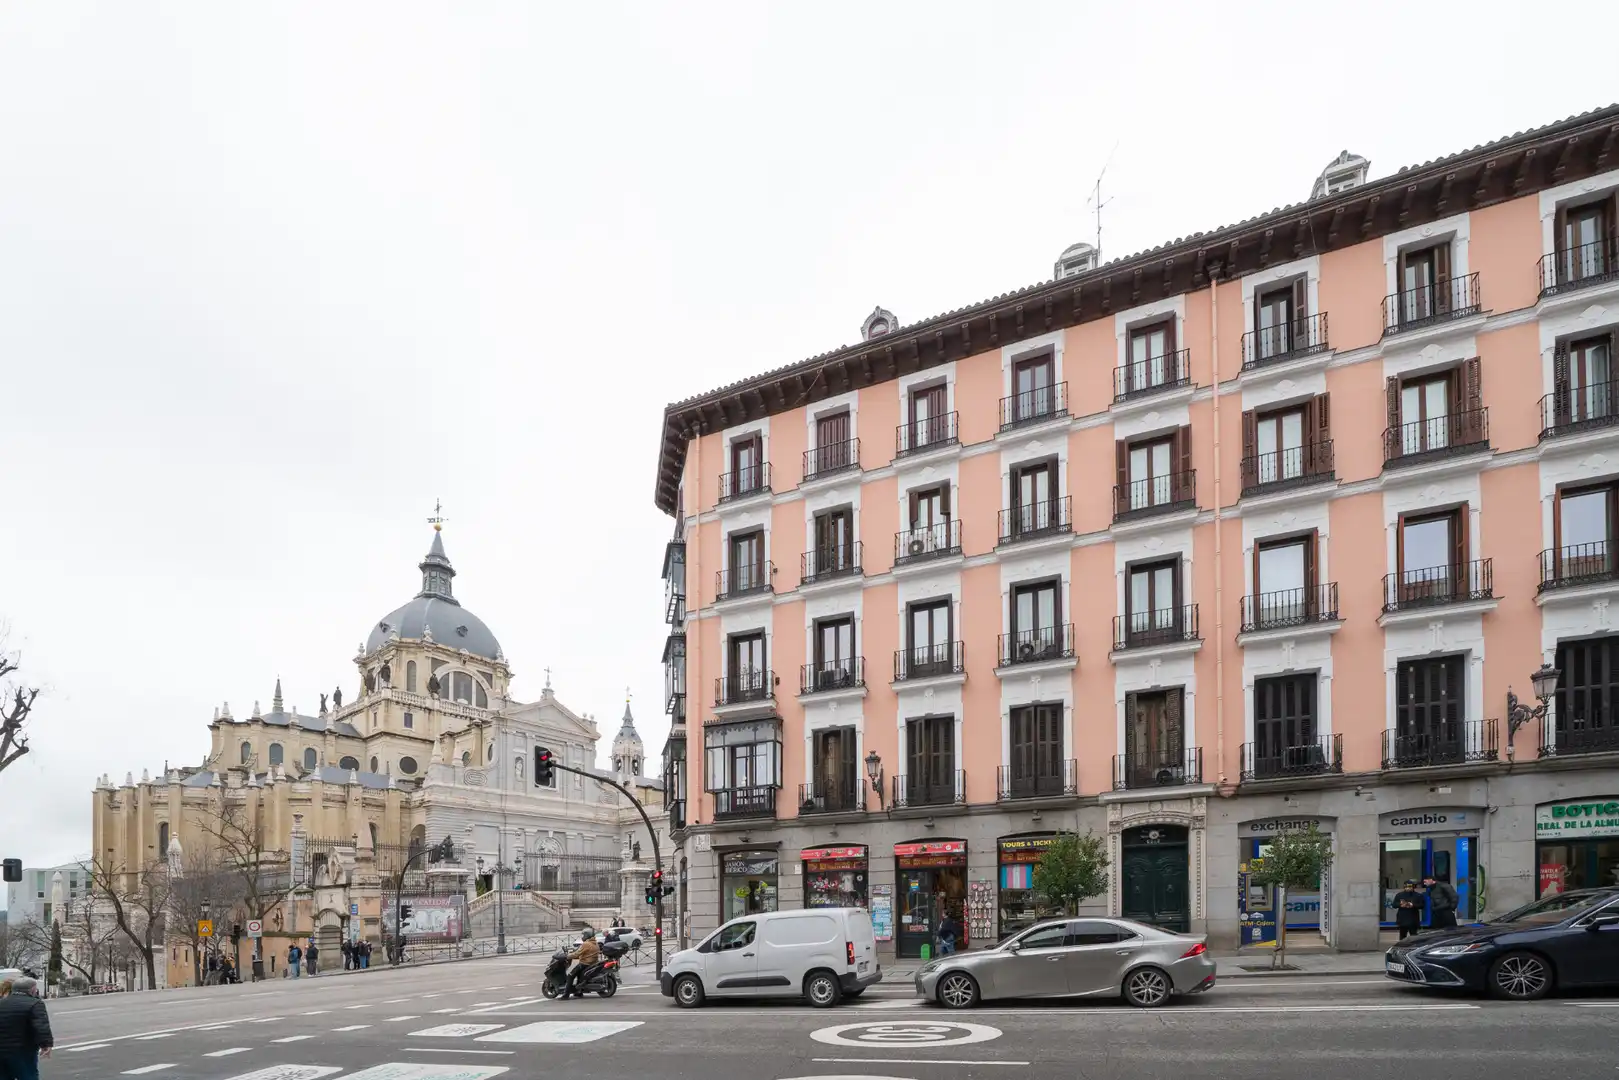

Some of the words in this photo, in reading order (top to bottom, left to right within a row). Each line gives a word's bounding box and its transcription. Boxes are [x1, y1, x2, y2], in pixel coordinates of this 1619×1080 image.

[1552, 802, 1619, 818] BOTIC
[1250, 818, 1320, 833] exchange
[1390, 813, 1447, 827] cambio
[1537, 822, 1561, 830] REAL
[1564, 821, 1577, 829] DE
[1580, 820, 1592, 828] LA
